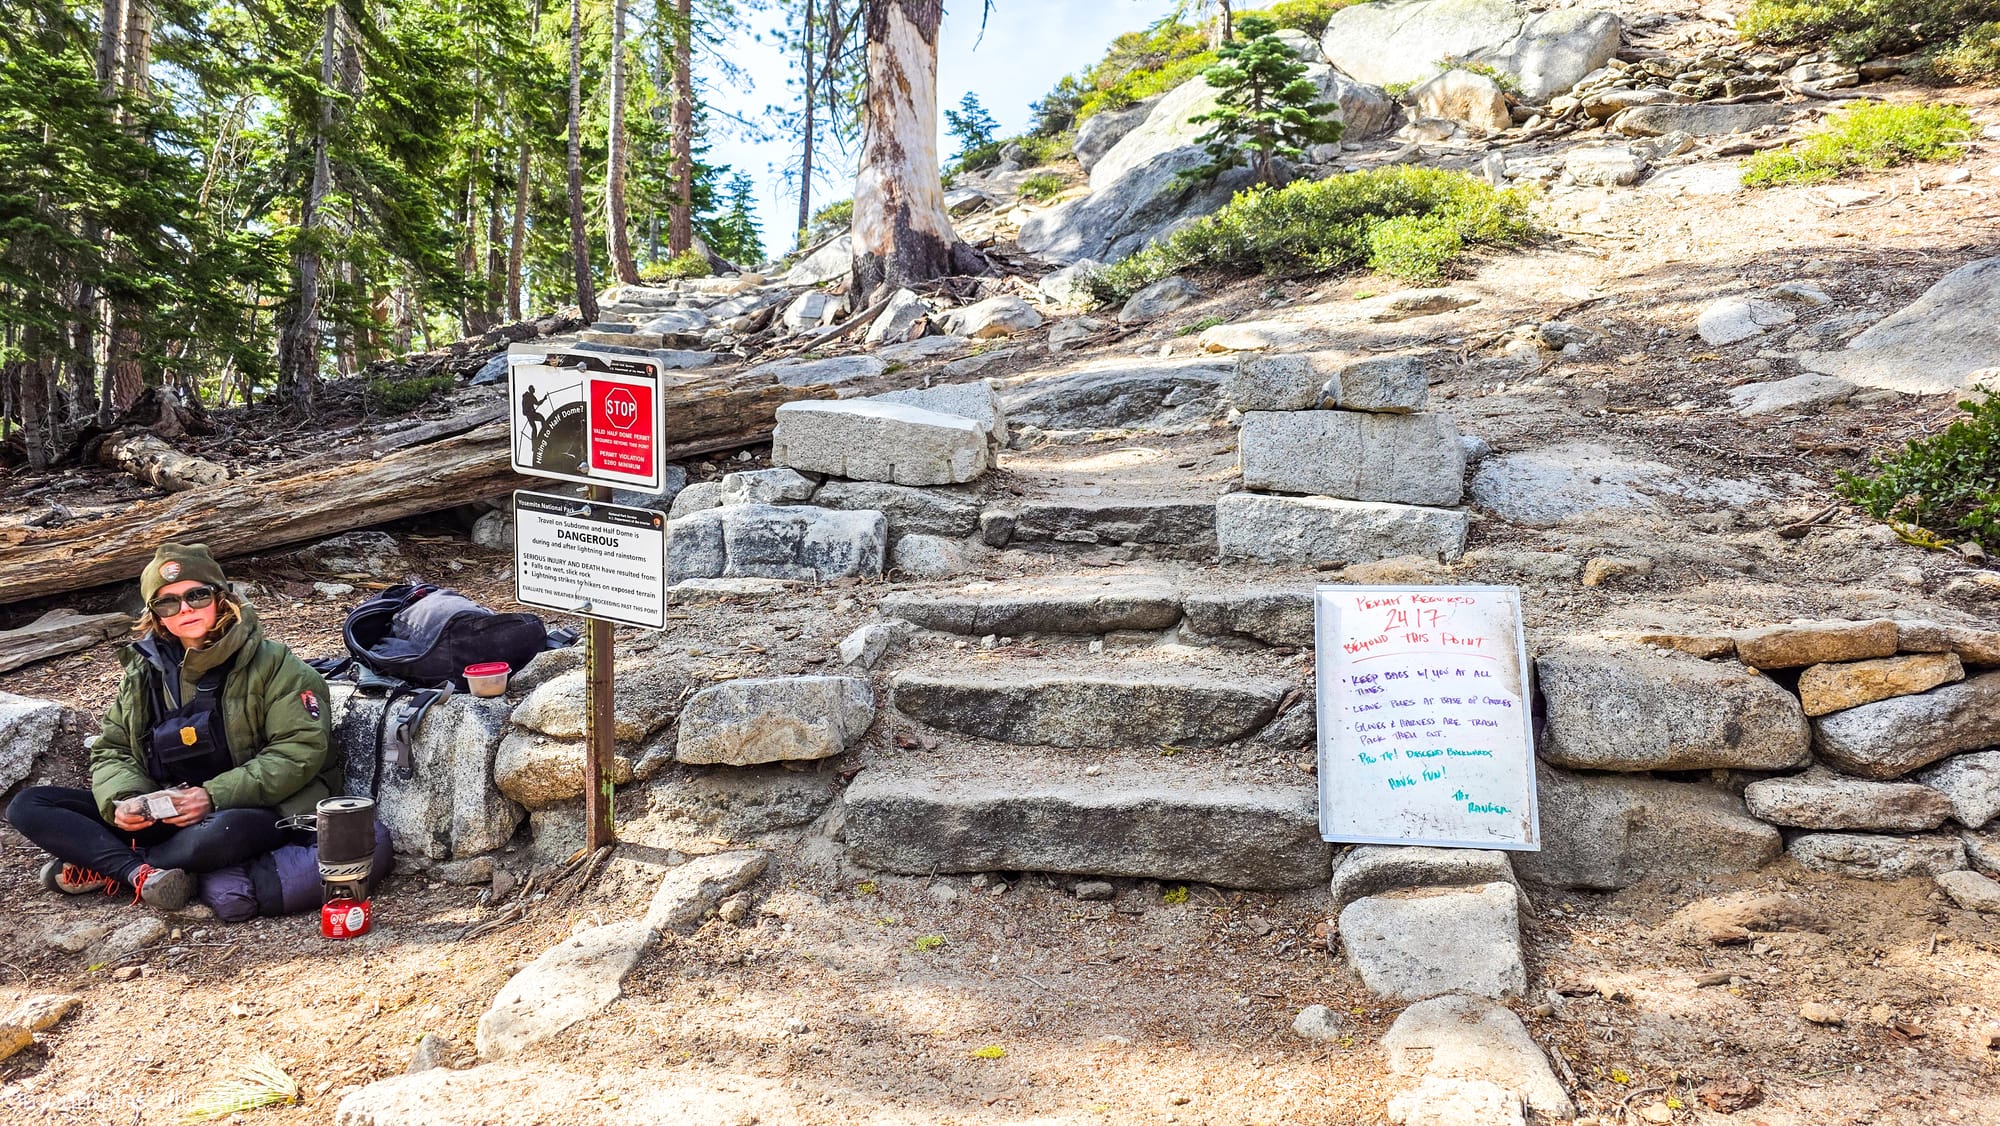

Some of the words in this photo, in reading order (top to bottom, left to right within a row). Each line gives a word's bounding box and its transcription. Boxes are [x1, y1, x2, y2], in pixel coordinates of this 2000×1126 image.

[607, 399, 636, 417] STOP
[536, 439, 548, 464] Hiking
[543, 429, 551, 438] to
[548, 413, 562, 429] Half
[561, 405, 584, 418] Dome?
[619, 431, 632, 439] DOME
[633, 433, 650, 441] PERMIT
[599, 450, 617, 458] PERMIT
[619, 453, 645, 463] VIOLATION
[618, 461, 641, 470] MINIMUM
[517, 498, 540, 508] Yosemite
[541, 502, 563, 512] National
[538, 516, 555, 525] Travel
[563, 520, 590, 530] Subdome
[602, 527, 615, 535] Half
[615, 529, 634, 538] Dome
[634, 531, 640, 539] is
[557, 529, 619, 548] DANGEROUS
[531, 537, 550, 548] during
[562, 542, 576, 551] after
[577, 545, 603, 556] lightning
[615, 551, 647, 563] rainstorms
[523, 552, 546, 562] SERIOUS
[546, 556, 567, 566] INJURY
[567, 560, 581, 568] AND
[581, 562, 601, 572] DEATH
[601, 565, 616, 575] have
[616, 569, 640, 579] resulted
[531, 561, 543, 570] Falls
[552, 566, 565, 574] wet,
[566, 568, 578, 576] slick
[531, 571, 557, 583] Lightning
[557, 576, 576, 585] strikes
[583, 579, 602, 589] hikers
[610, 586, 635, 595] exposed
[635, 589, 656, 599] terrain
[522, 584, 544, 594] EVALUATE
[553, 590, 574, 599] WEATHER
[574, 594, 591, 602] BEFORE
[592, 597, 620, 608] PROCEEDING
[643, 607, 658, 615] POINT
[1356, 595, 1402, 612] PERMIT
[1411, 594, 1475, 605] REQUIRED
[1343, 634, 1388, 654] BEYOND
[1400, 632, 1429, 643] THIS
[1440, 632, 1489, 648] POINT
[1351, 673, 1378, 686] KEEP
[1384, 670, 1409, 681] BAGS
[1455, 669, 1466, 677] AT
[1474, 669, 1492, 678] ALL
[1352, 702, 1382, 714] LEAVE
[1391, 699, 1416, 709] POLES
[1423, 697, 1435, 705] AT
[1440, 696, 1463, 705] BASE
[1468, 696, 1479, 705] OF
[1482, 696, 1512, 708] CABLES
[1354, 720, 1386, 733] GLOVES
[1390, 720, 1396, 728] &
[1400, 718, 1436, 729] HARNESS
[1442, 717, 1462, 726] ARE
[1467, 718, 1499, 728] TRASH
[1360, 734, 1386, 746] PACK
[1392, 731, 1418, 741] THEM
[1358, 752, 1377, 766] PRO
[1405, 749, 1443, 759] DESCEND
[1388, 774, 1417, 791] HAVE
[1422, 764, 1448, 782] FUN!
